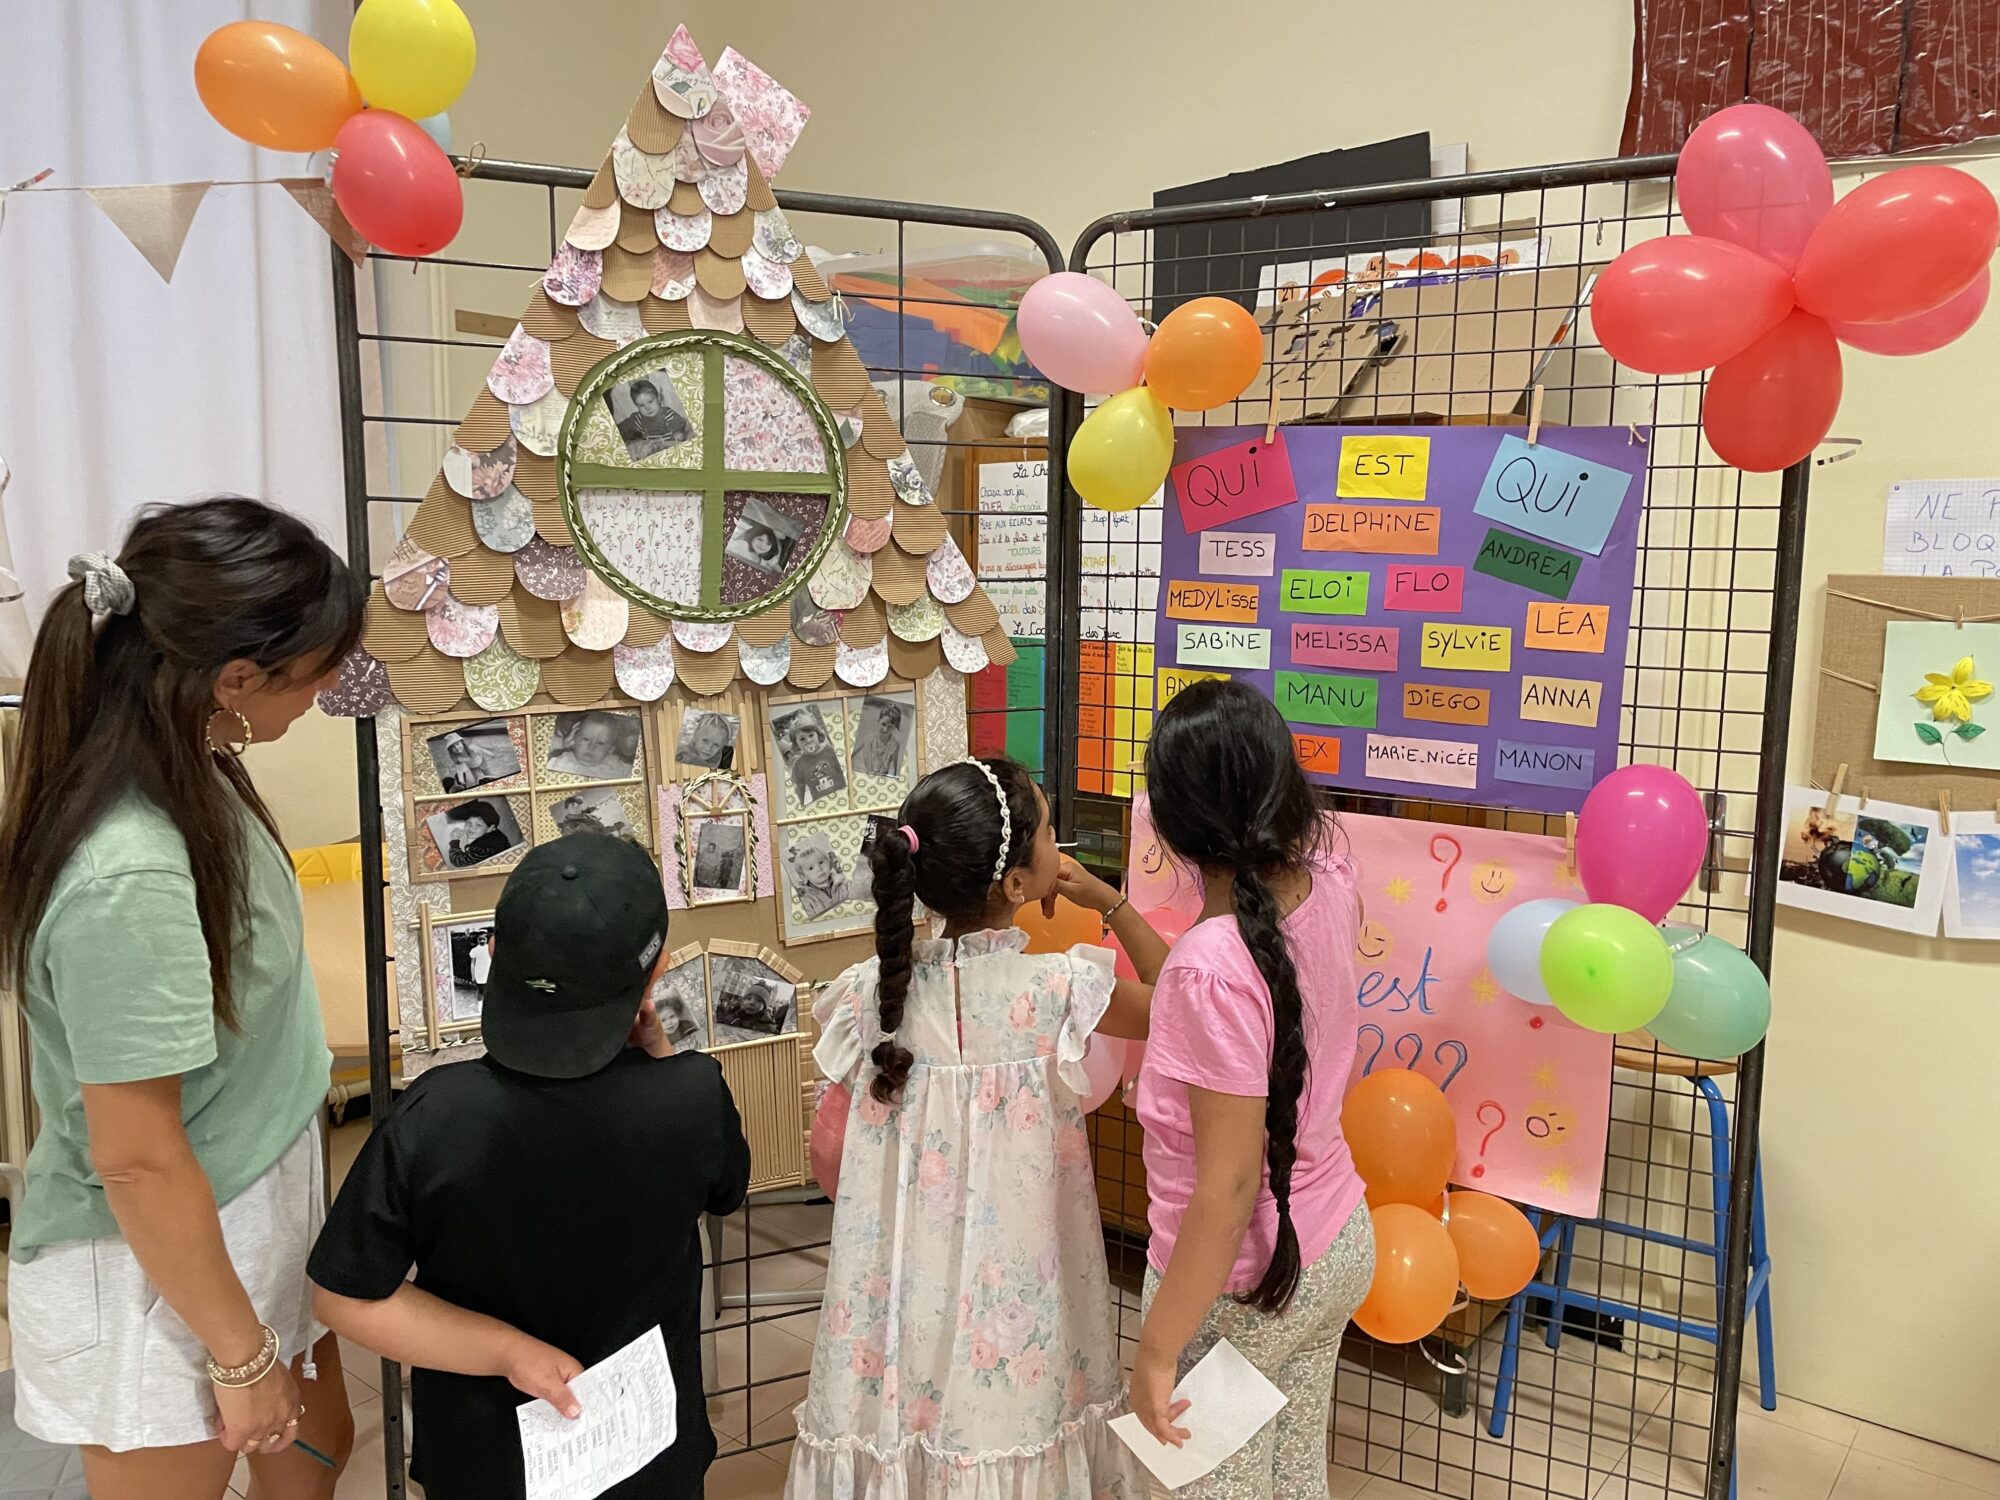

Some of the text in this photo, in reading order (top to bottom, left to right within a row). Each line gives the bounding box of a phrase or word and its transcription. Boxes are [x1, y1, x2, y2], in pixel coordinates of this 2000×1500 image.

[1354, 454, 1415, 477] EST
[1915, 493, 1962, 520] NE
[1209, 539, 1265, 558] TESS
[1905, 531, 1995, 553] BLOQ
[1395, 571, 1450, 592] FLO
[1536, 610, 1596, 636] LÉA
[1166, 676, 1193, 696] AN
[1288, 683, 1365, 707] MANU
[1524, 684, 1592, 709] ANNA
[1299, 739, 1328, 758] EX
[1500, 749, 1582, 771] MANON
